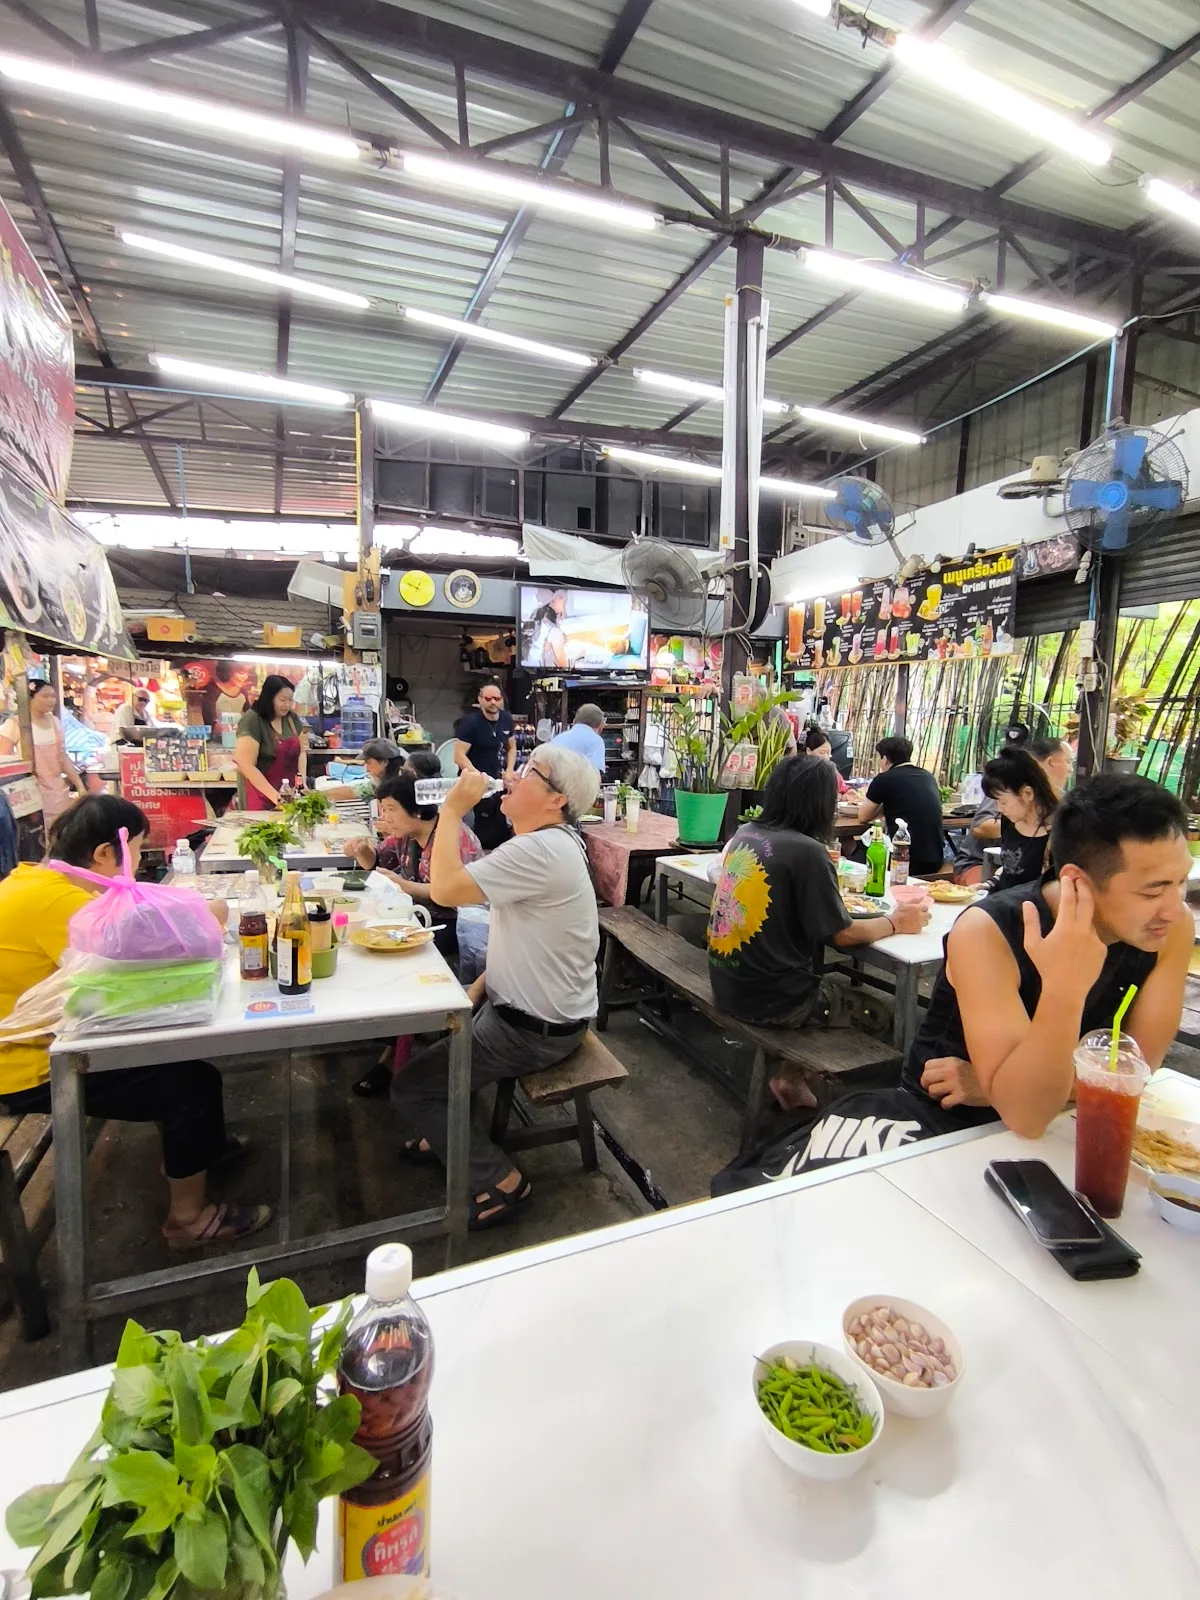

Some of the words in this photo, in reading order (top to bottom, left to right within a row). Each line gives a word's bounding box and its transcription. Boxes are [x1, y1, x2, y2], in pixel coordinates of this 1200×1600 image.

[962, 581, 988, 594] Drink
[989, 576, 1011, 590] Menu
[796, 1114, 922, 1171] NIKE
